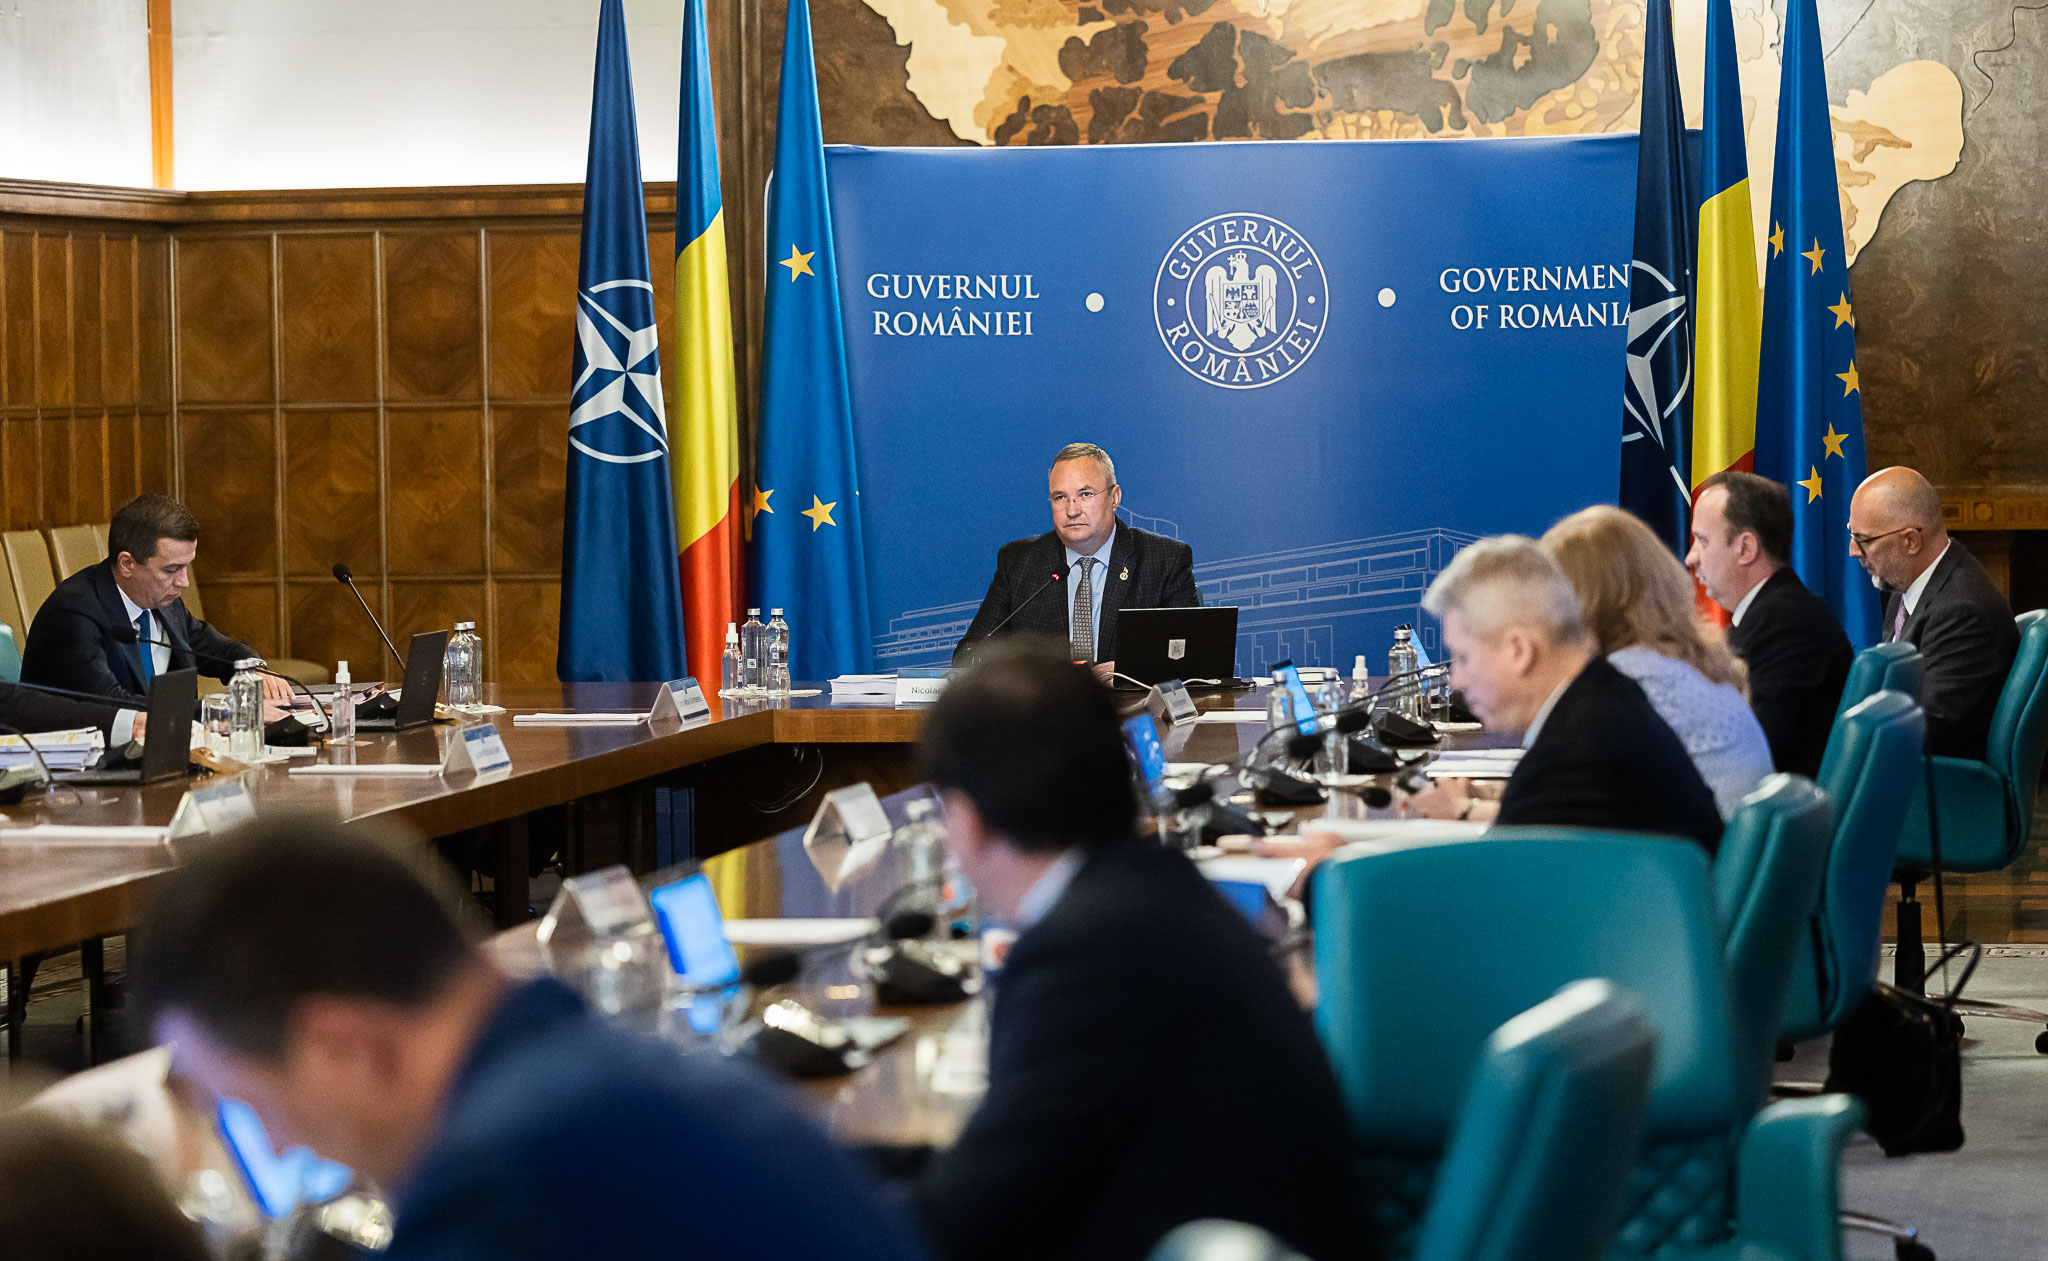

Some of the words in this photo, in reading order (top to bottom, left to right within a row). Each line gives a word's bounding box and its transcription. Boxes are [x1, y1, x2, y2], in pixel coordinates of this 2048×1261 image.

[1168, 219, 1313, 280] GUVERNUL
[866, 273, 1040, 300] GUVERNUL
[1439, 263, 1631, 293] GOVERNMEN
[873, 305, 1035, 337] ROMÂNIEI
[1450, 305, 1490, 330] OF
[1165, 318, 1318, 383] ROMÂNIEI
